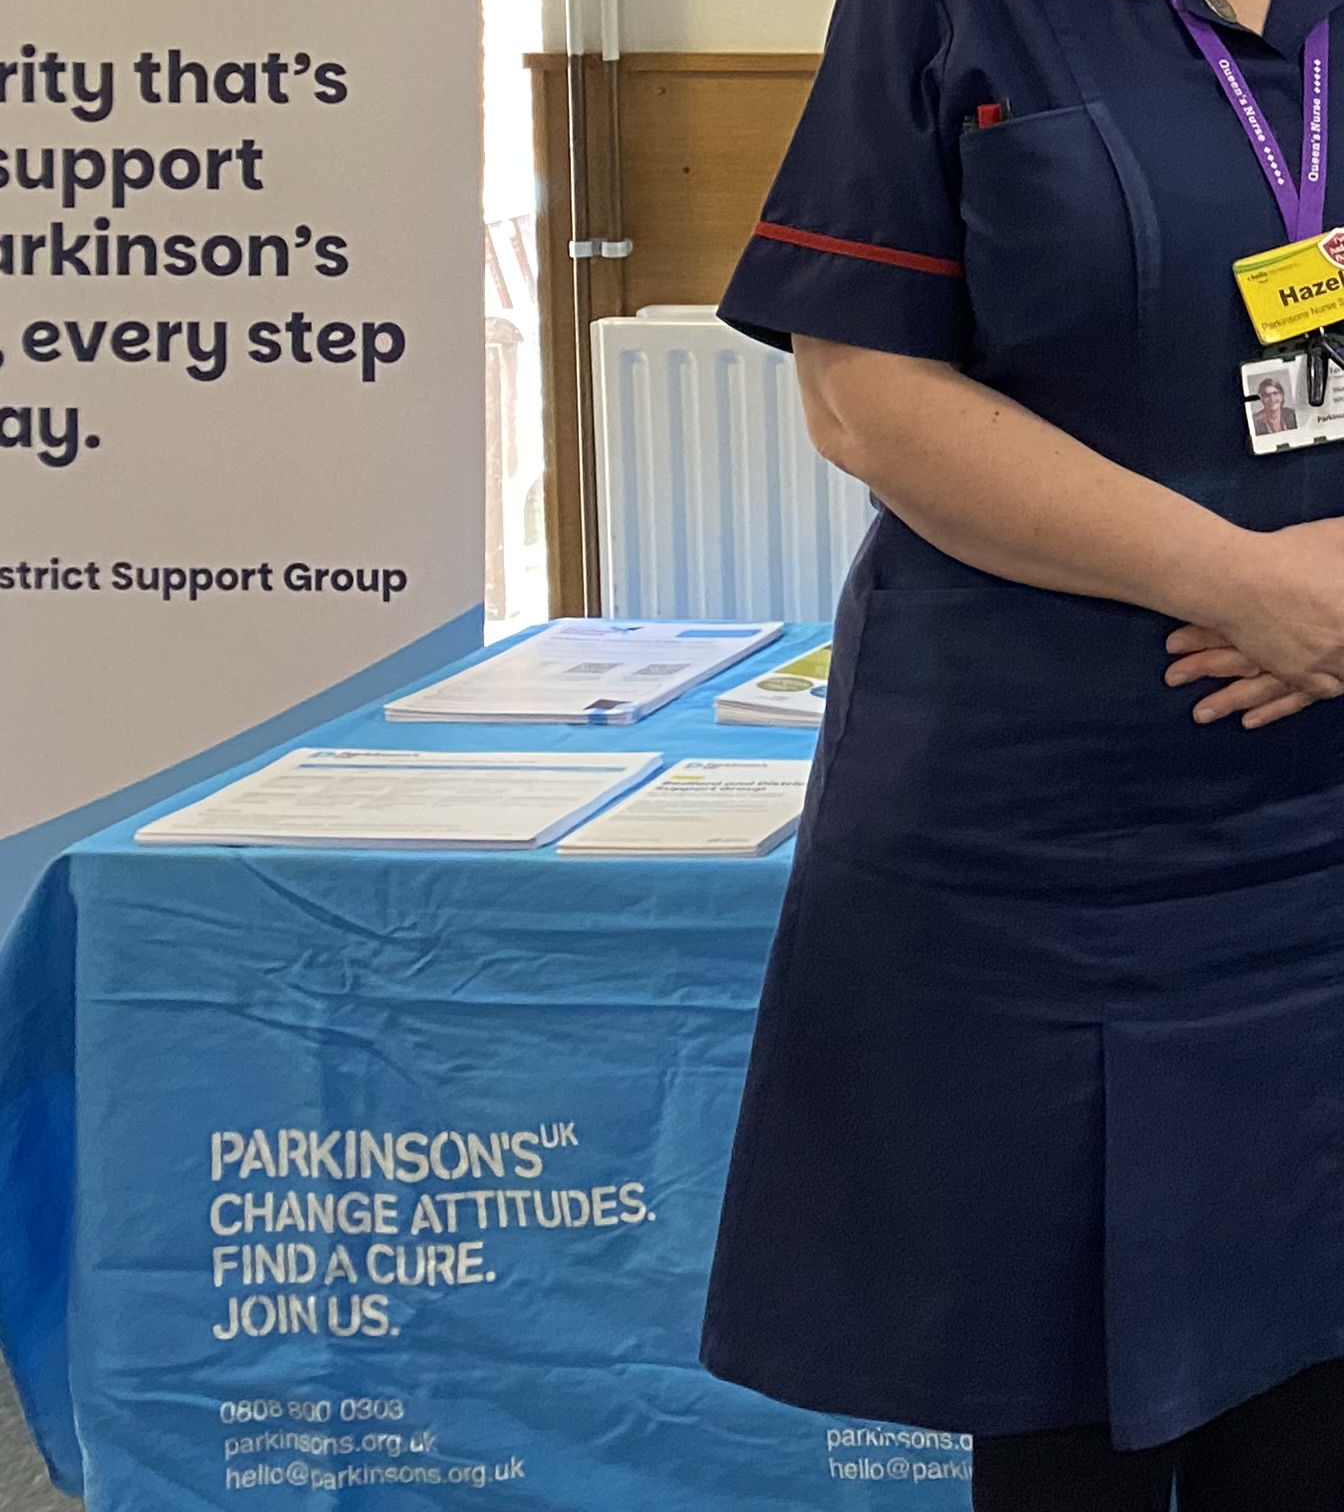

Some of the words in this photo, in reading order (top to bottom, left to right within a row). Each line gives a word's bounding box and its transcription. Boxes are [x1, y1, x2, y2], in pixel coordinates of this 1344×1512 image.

[134, 49, 348, 104] that's
[1218, 58, 1248, 106] Queen's
[1243, 105, 1266, 142] Nurse
[1310, 98, 1321, 133] Nurse
[1308, 134, 1321, 182] Queen's
[1311, 300, 1338, 315] Nurse
[22, 320, 228, 382] every
[248, 312, 407, 383] step
[110, 561, 274, 601] Support
[283, 562, 408, 603] Group
[211, 1129, 543, 1183] PARKINSON'S
[210, 1192, 398, 1236] CHANGE
[411, 1182, 656, 1236] ATTITUDES.
[212, 1244, 317, 1288] FIND
[324, 1245, 358, 1285] A
[367, 1241, 496, 1287] CURE.
[212, 1296, 317, 1340] JOIN
[329, 1295, 400, 1337] US.
[219, 1400, 282, 1423] 0808
[289, 1400, 330, 1422] 800
[340, 1399, 404, 1421] 0303
[225, 1432, 437, 1461] parkinsons.org.uk
[225, 1457, 525, 1490] hello@parkinsons.org.uk
